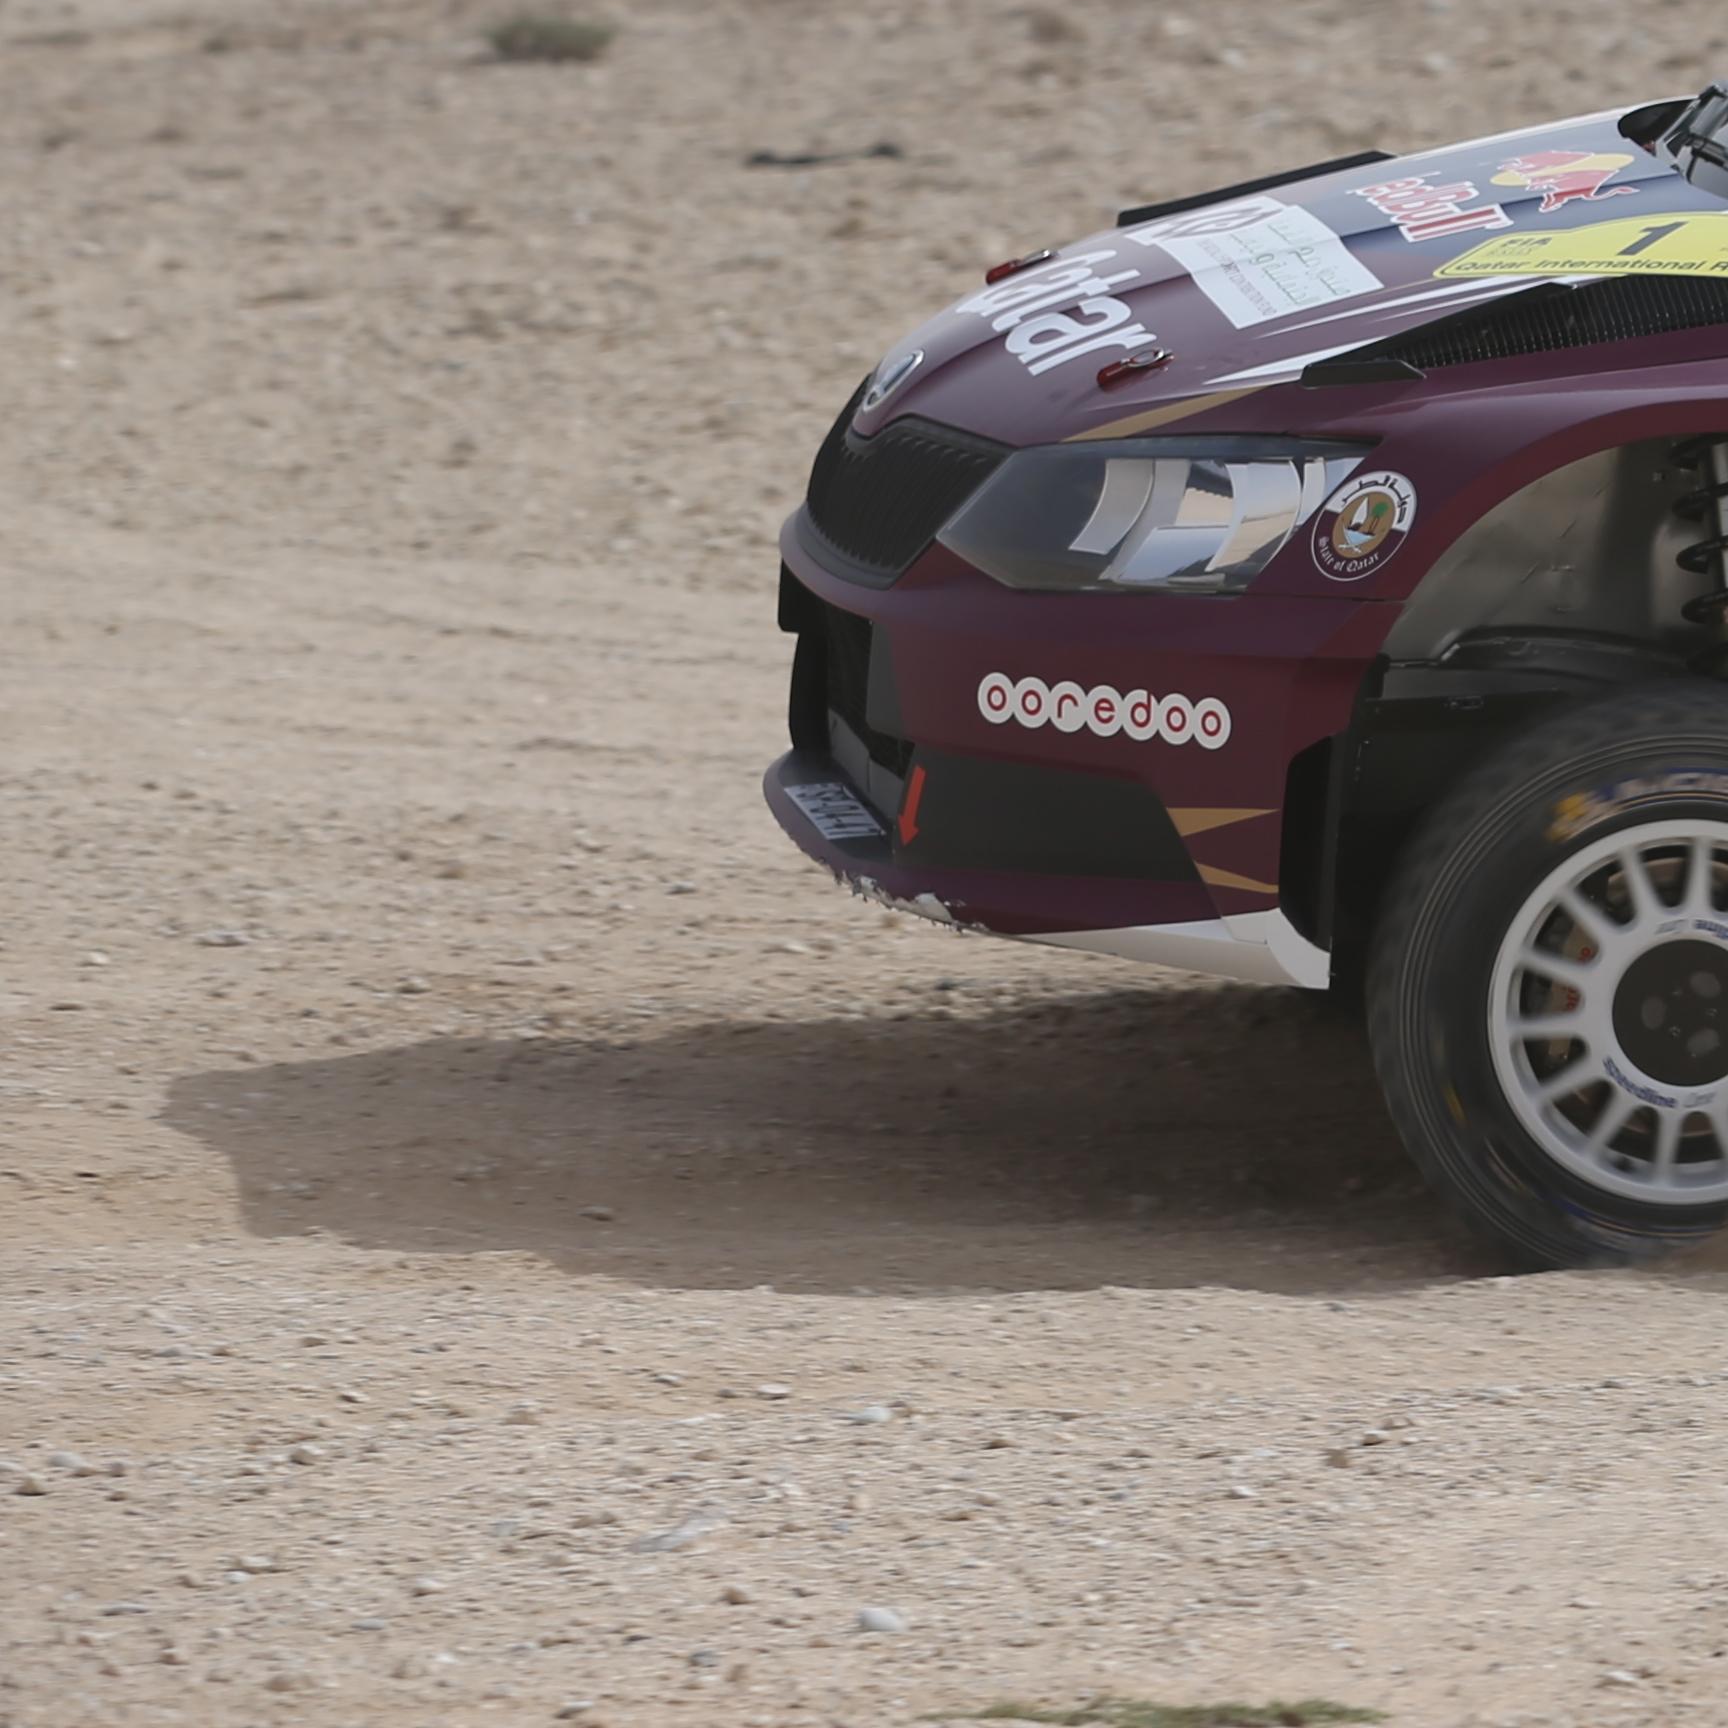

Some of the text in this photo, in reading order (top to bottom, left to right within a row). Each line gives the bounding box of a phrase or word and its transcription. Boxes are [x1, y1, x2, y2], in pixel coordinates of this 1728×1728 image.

[1616, 221, 1690, 256] 1
[1456, 260, 1530, 271] Qatar
[1535, 258, 1704, 271] International
[1318, 536, 1380, 573] State of Qatar
[983, 682, 1225, 741] ooredoo
